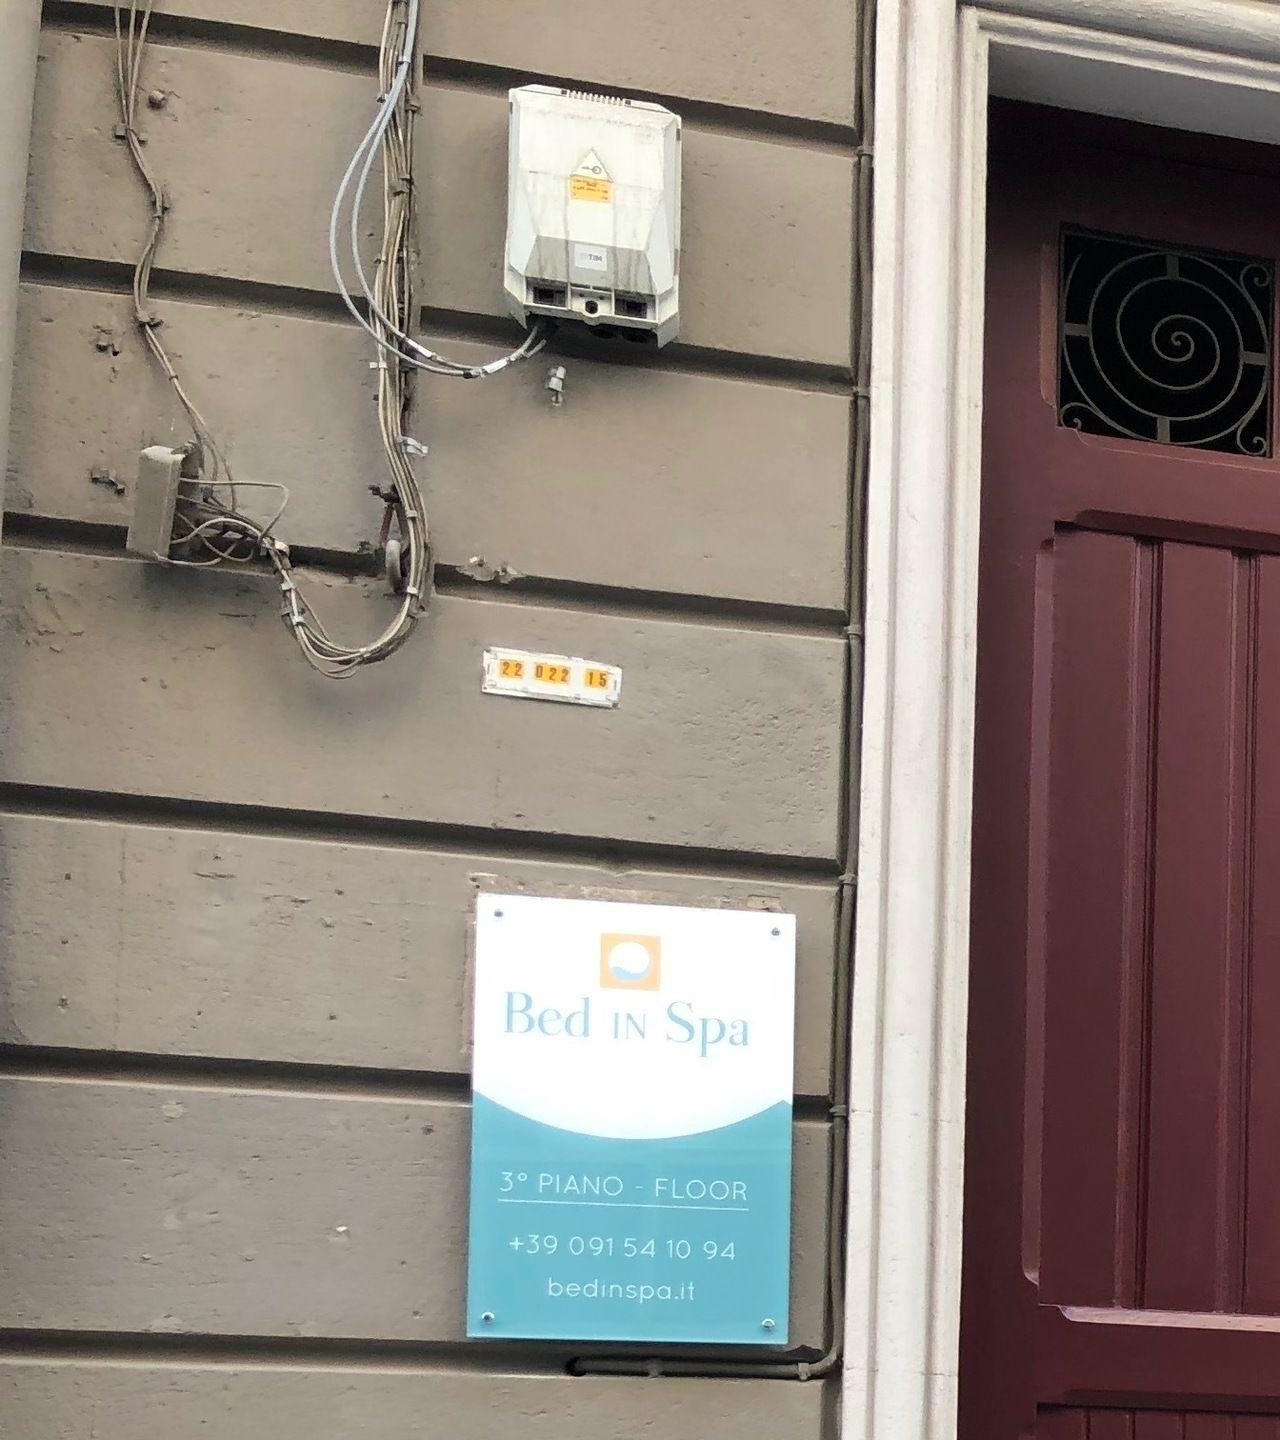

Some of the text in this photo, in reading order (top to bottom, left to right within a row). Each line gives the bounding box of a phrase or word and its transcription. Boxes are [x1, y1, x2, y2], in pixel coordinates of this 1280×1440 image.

[502, 661, 523, 677] 22
[588, 671, 608, 688] 15
[504, 991, 749, 1057] Bed IN Spa
[499, 1171, 528, 1192] 3°
[539, 1172, 624, 1196] PIANO
[655, 1178, 747, 1201] FLOOR
[509, 1234, 735, 1260] +39 091 54 10 94
[548, 1277, 695, 1304] bedinspa.it
